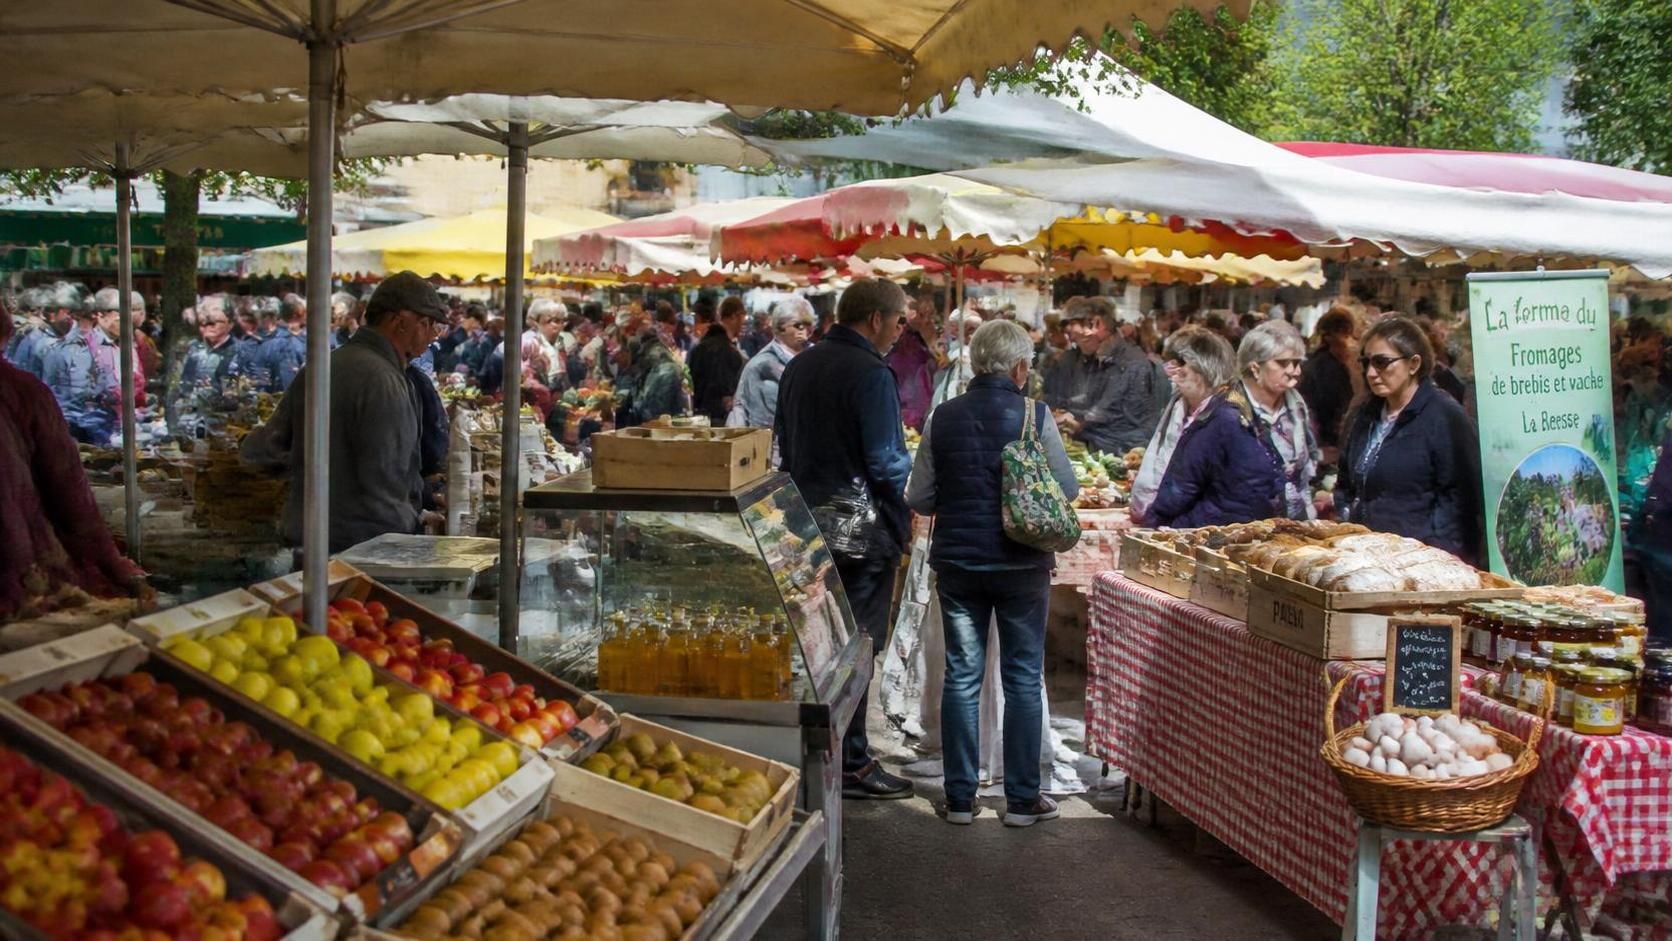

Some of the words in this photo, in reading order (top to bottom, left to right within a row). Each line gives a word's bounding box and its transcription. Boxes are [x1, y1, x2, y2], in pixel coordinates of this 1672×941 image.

[1485, 298, 1509, 331] La
[1576, 297, 1596, 327] du
[1511, 343, 1582, 370] Fromages
[1492, 375, 1506, 396] de
[1510, 374, 1550, 396] brebis
[1554, 376, 1566, 392] et
[1569, 366, 1604, 391] vache
[1522, 411, 1537, 433] La
